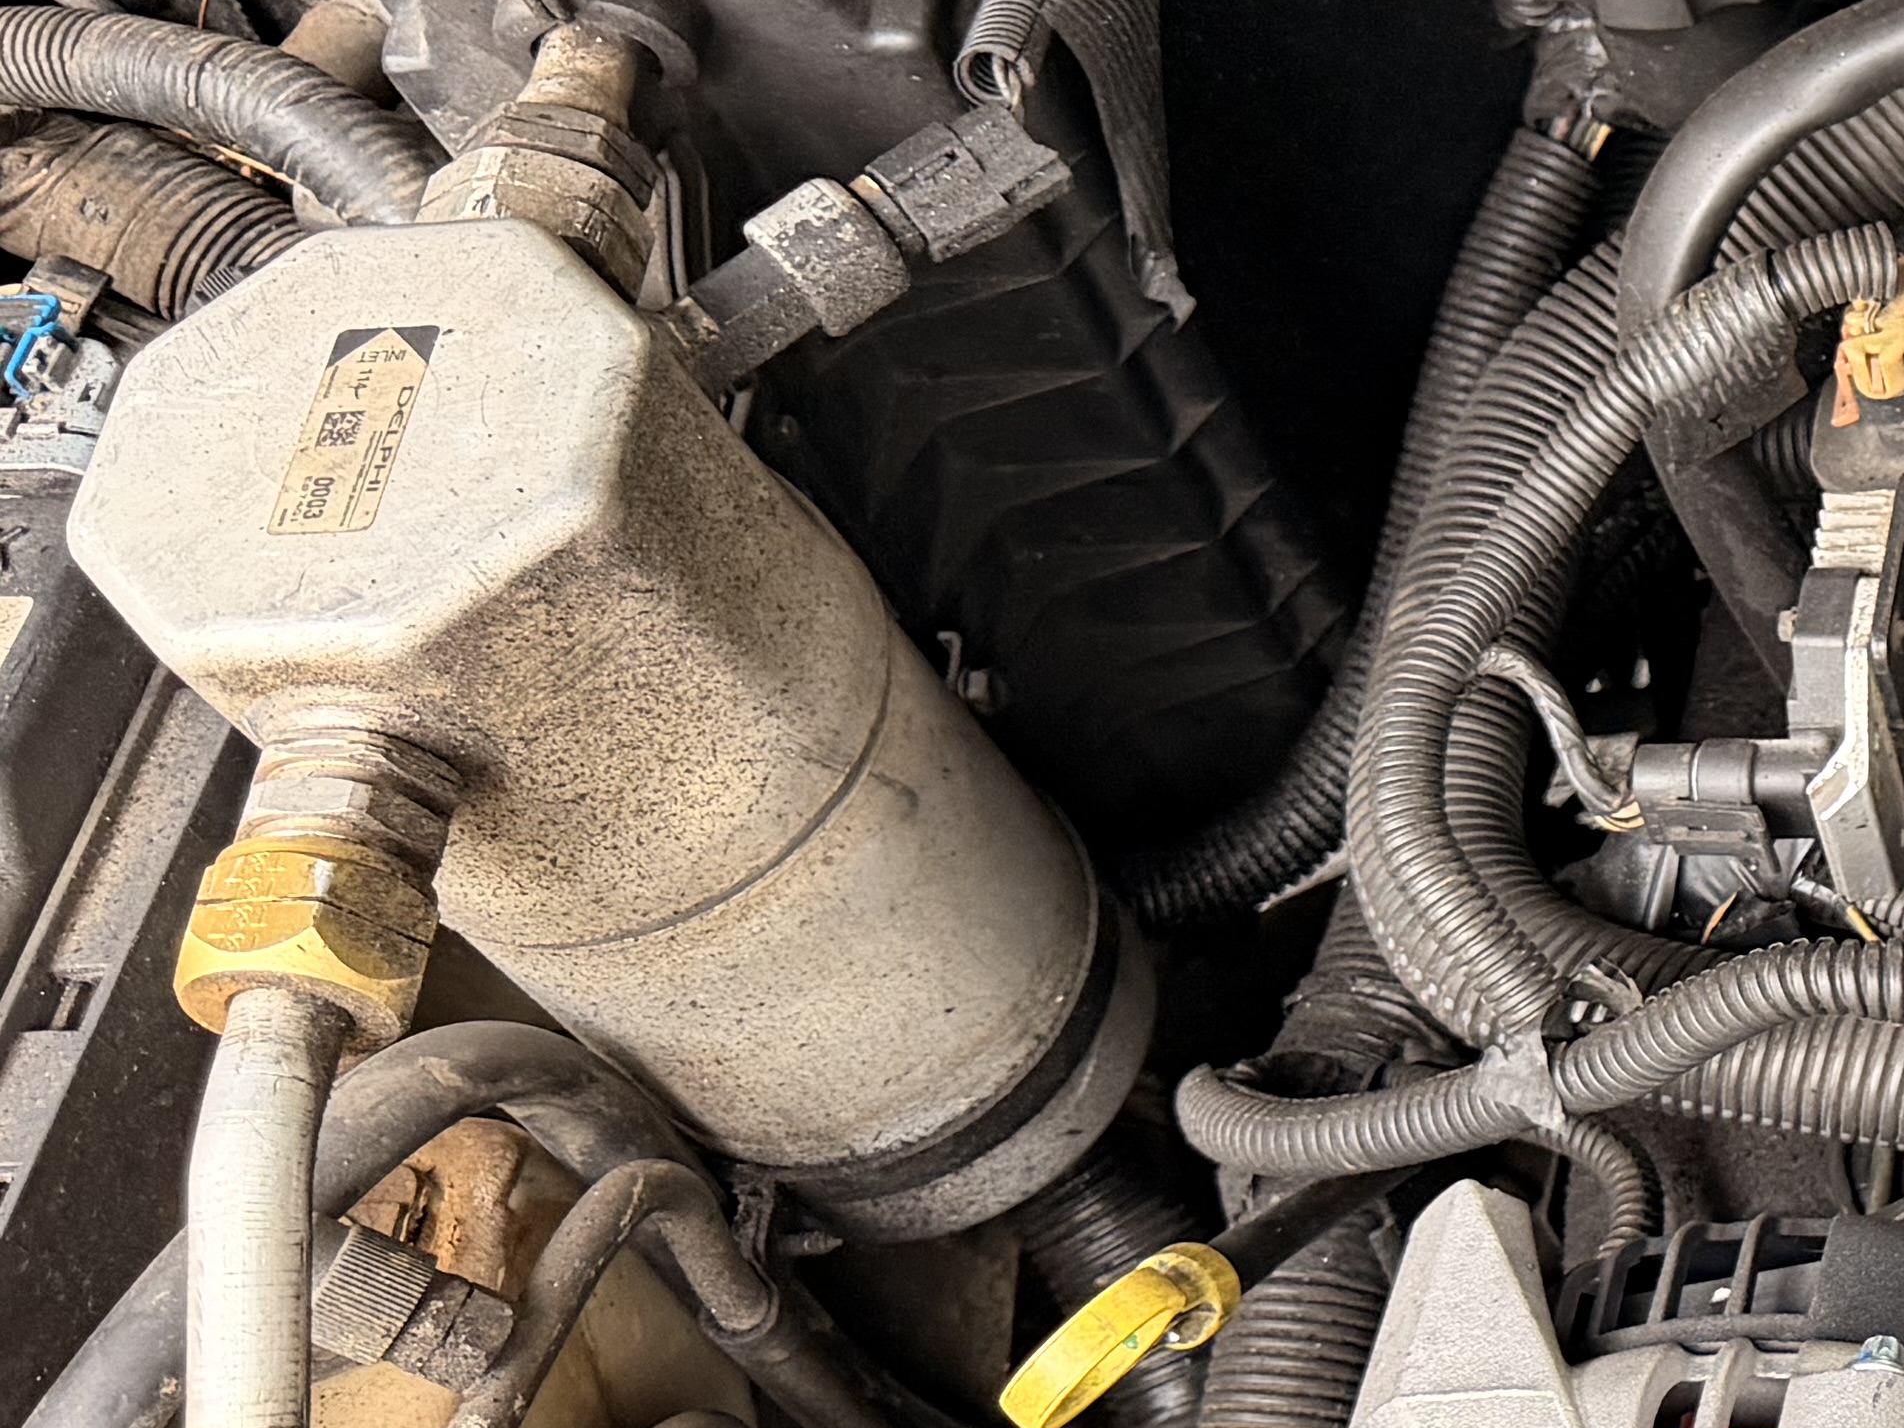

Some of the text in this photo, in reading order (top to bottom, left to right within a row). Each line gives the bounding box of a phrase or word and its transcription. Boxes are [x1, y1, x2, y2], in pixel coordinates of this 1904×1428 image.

[356, 349, 407, 363] INLET
[366, 385, 415, 492] DELPHI
[303, 476, 335, 520] 0003
